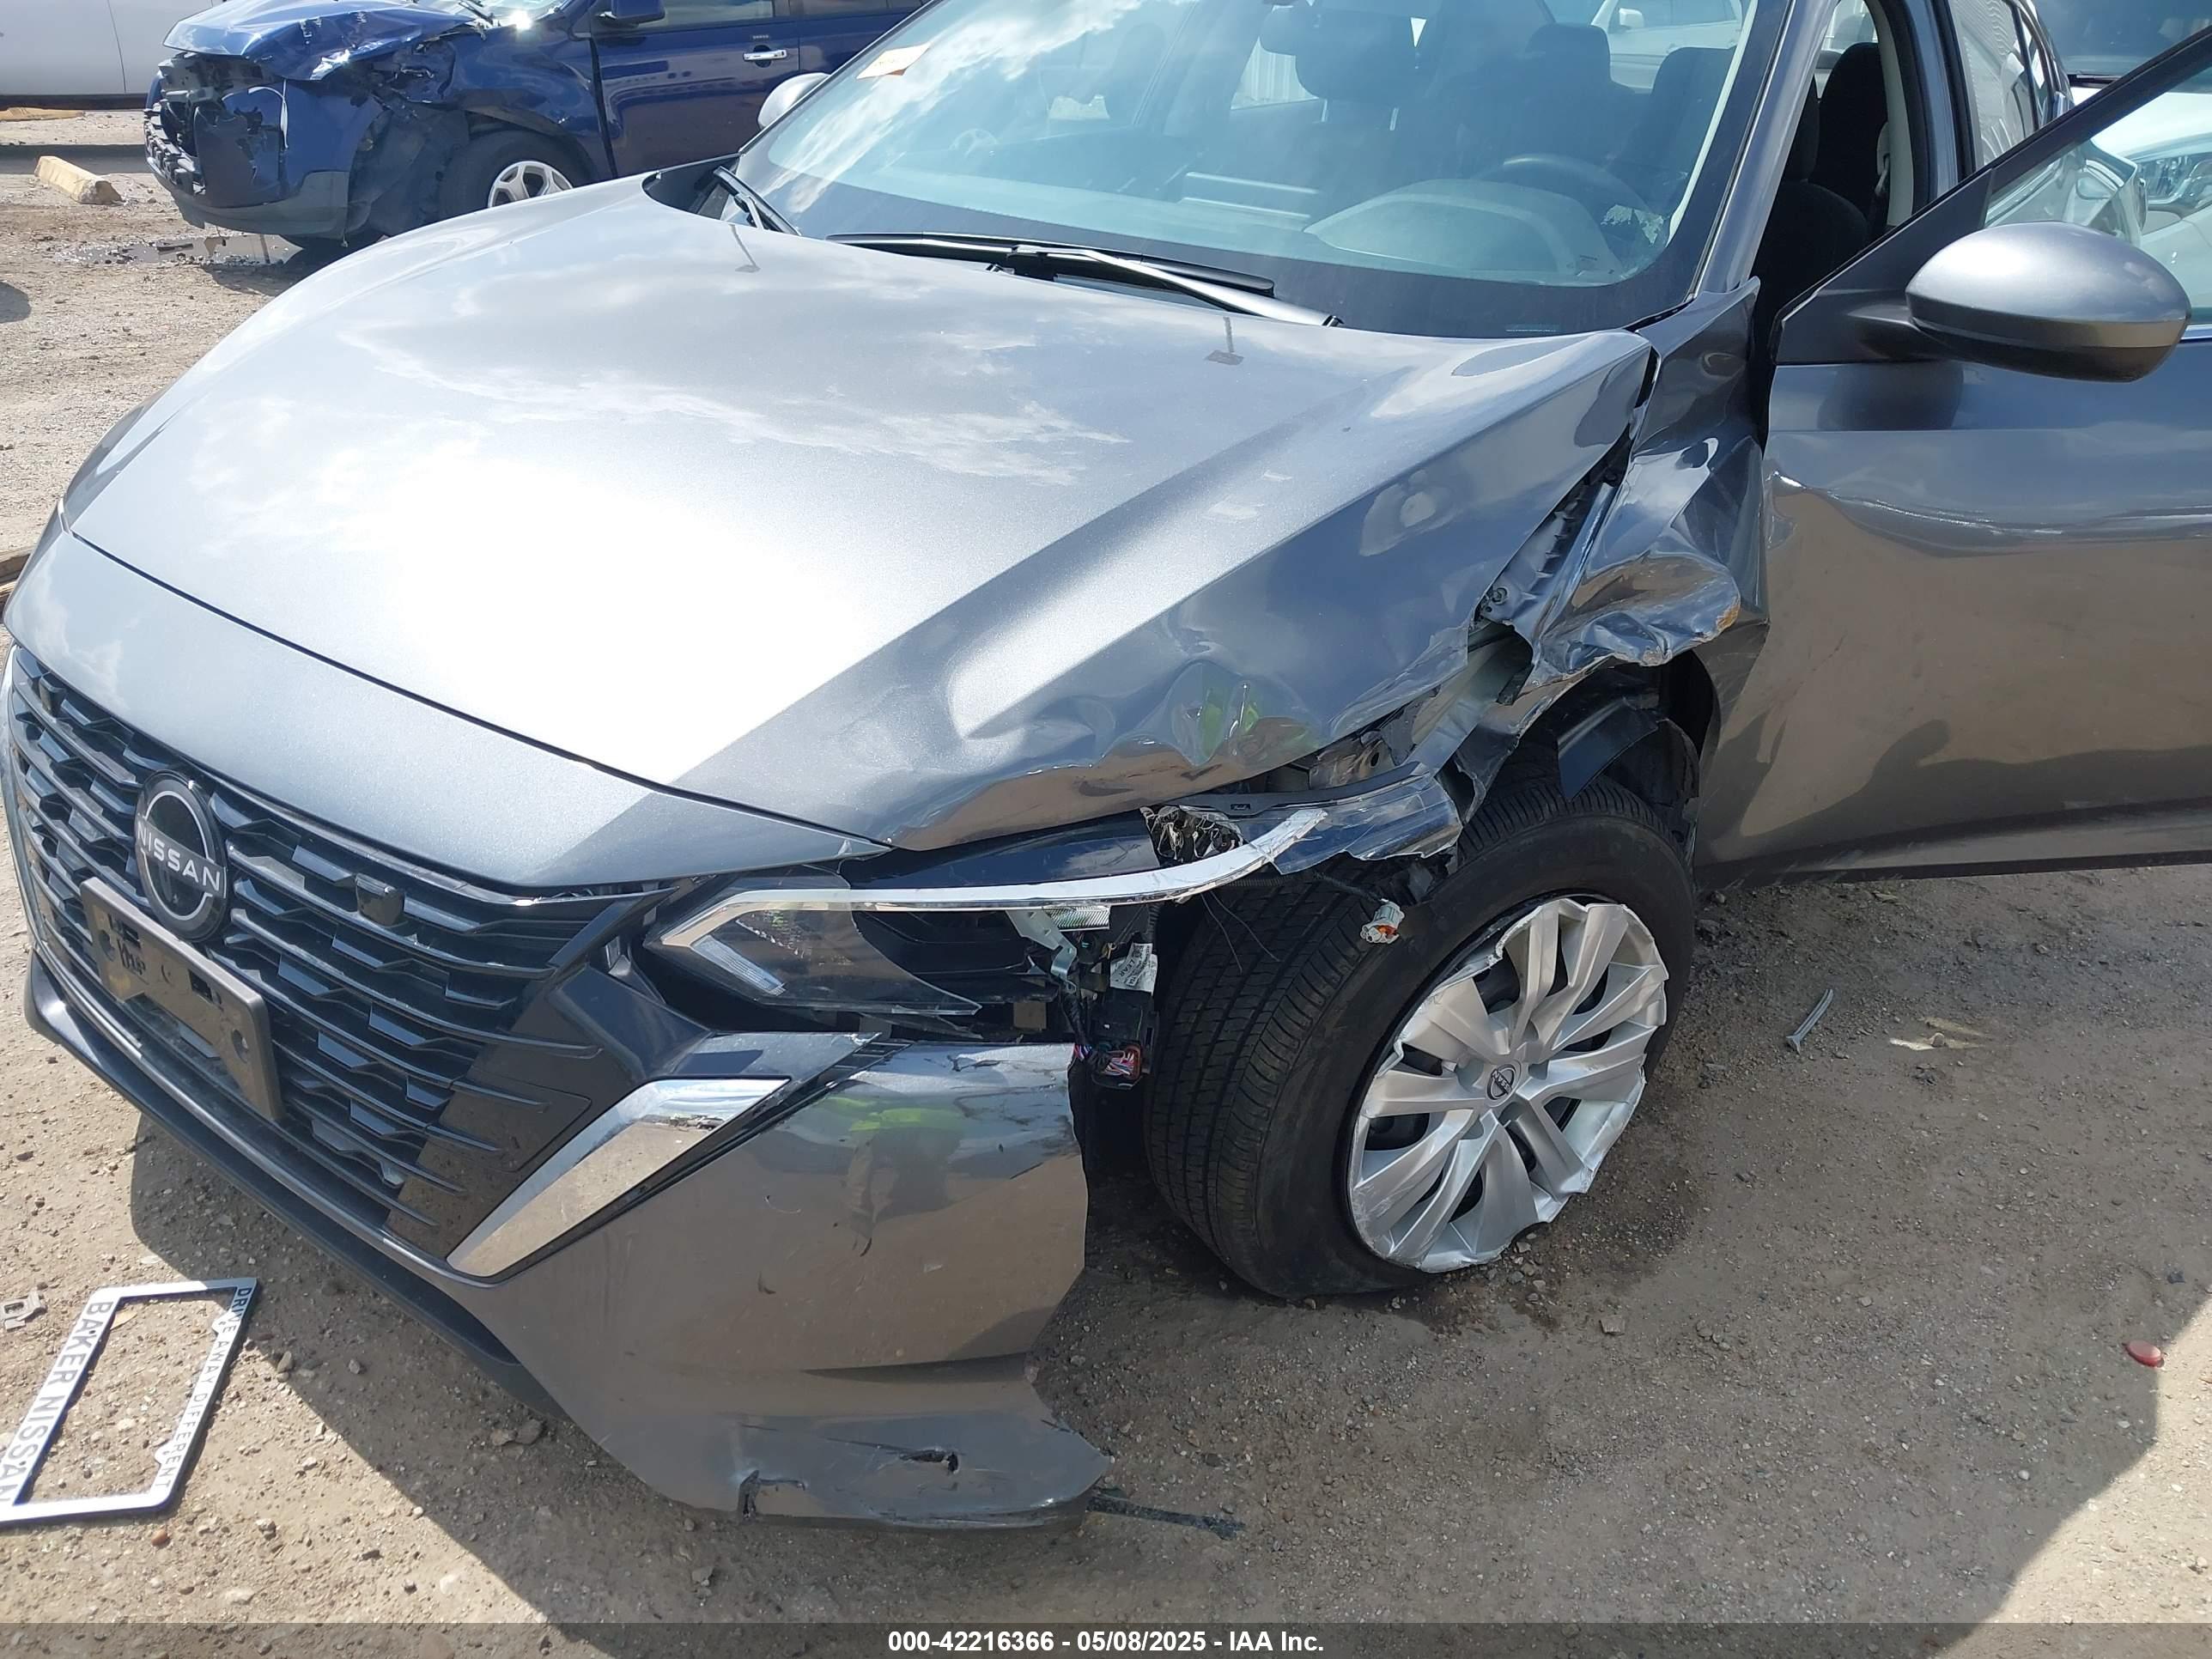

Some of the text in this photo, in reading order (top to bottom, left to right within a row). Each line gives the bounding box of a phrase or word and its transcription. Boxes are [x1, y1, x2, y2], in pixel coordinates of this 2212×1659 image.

[137, 820, 221, 891] NISSAN
[1119, 958, 1136, 978] LEAR
[1492, 1070, 1511, 1091] SSAN
[0, 1300, 114, 1503] BAKER NISSAN
[155, 1286, 252, 1488] DRIVE AWAY DIFFERENT
